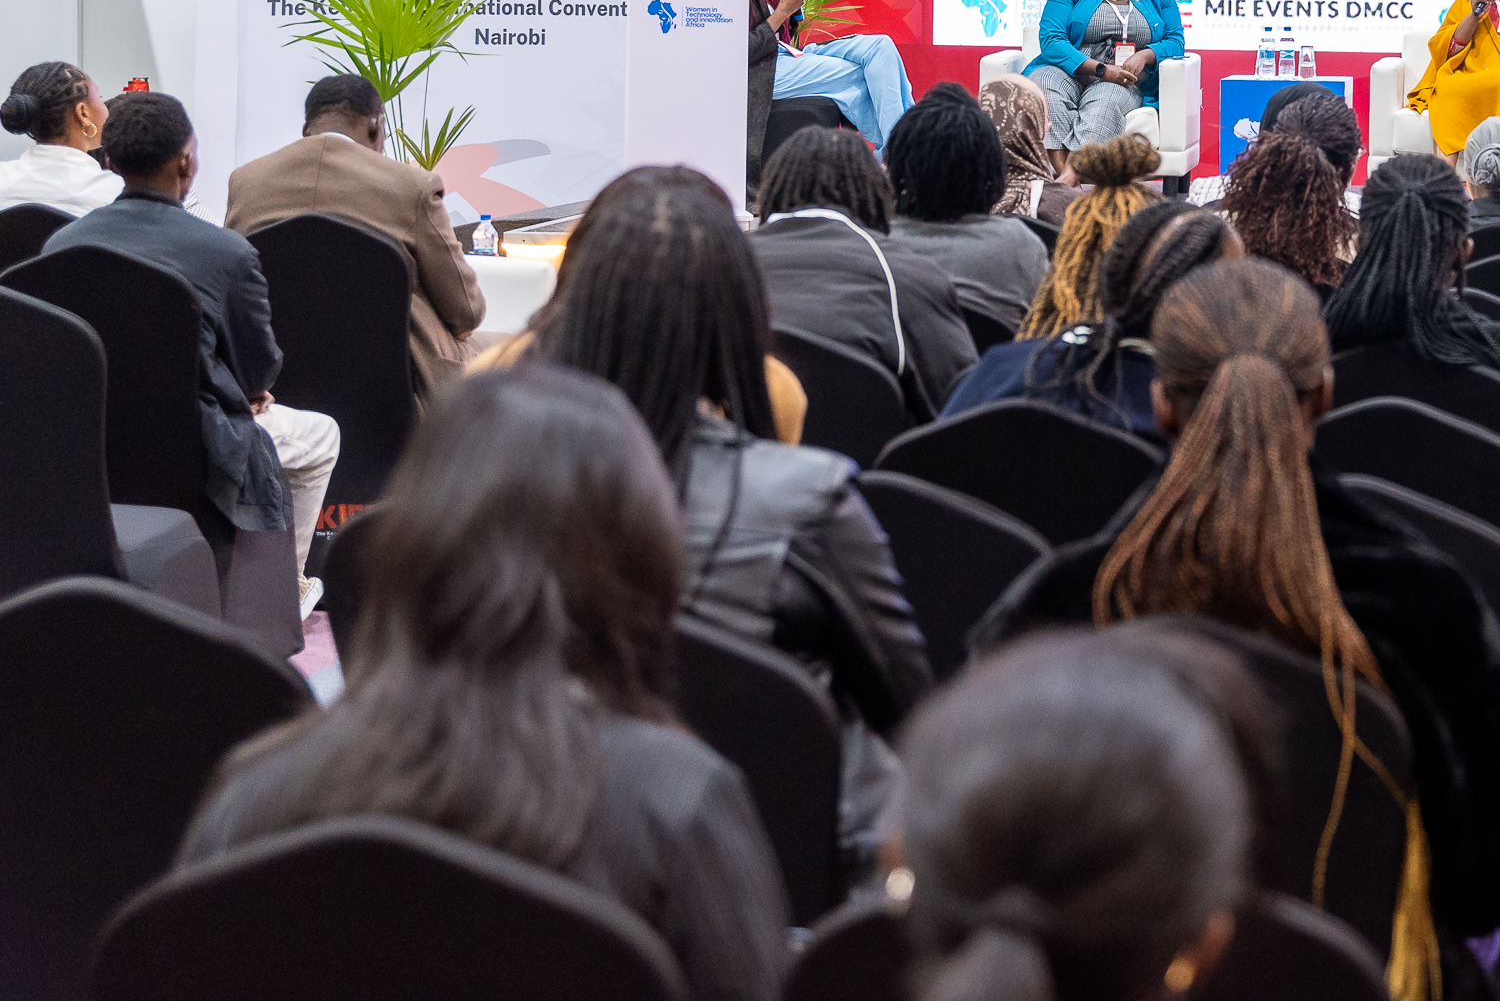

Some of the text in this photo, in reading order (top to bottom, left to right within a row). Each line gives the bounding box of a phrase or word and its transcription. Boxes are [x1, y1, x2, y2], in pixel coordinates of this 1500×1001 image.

[685, 11, 723, 19] Technology
[1205, 0, 1414, 19] MIE EVENTS DMCC
[474, 27, 547, 46] Nairobi
